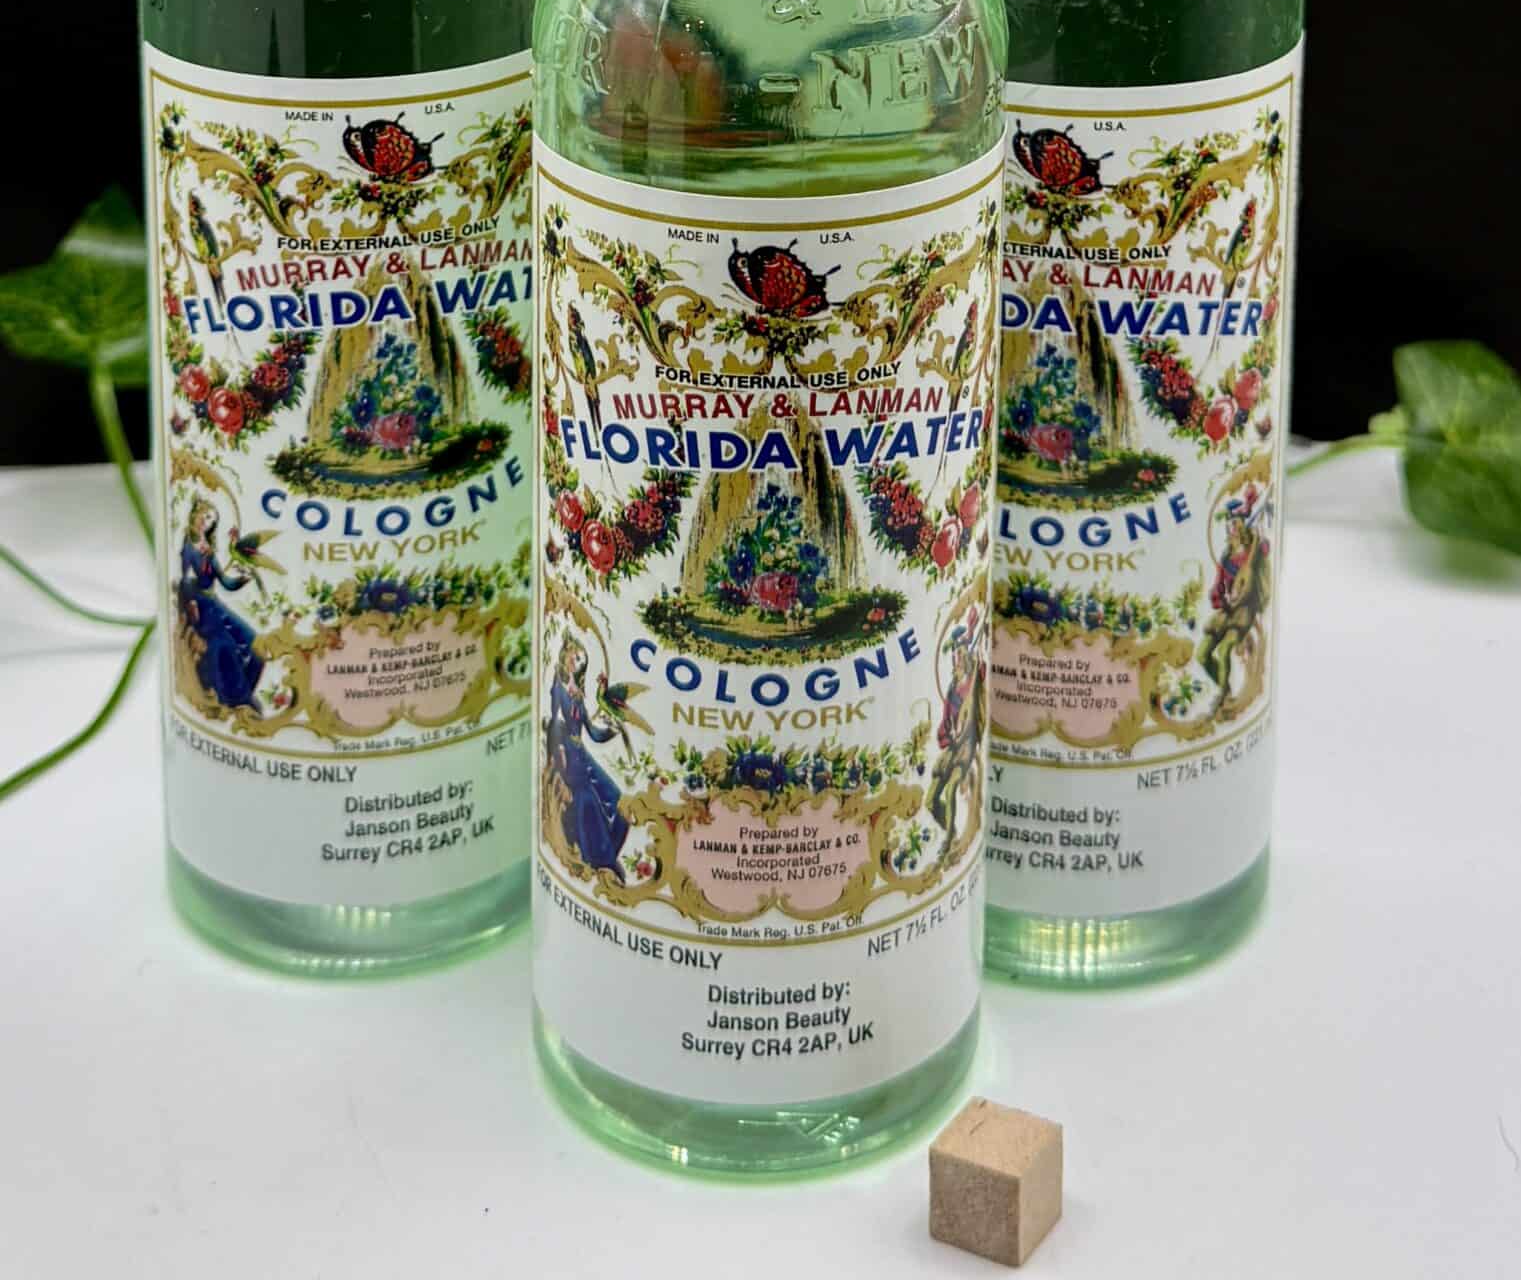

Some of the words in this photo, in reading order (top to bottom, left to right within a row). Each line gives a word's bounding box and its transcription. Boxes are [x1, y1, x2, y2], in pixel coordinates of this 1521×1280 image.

[284, 111, 318, 121] MADE
[321, 111, 334, 121] IN
[1093, 122, 1127, 131] U.S.A.
[278, 237, 313, 250] FOR
[319, 237, 412, 252] EXTERNAL
[420, 228, 453, 243] USE
[462, 216, 500, 236] ONLY
[667, 227, 701, 242] MADE
[703, 230, 720, 244] IN
[819, 230, 855, 245] U.S.A.
[1003, 241, 1076, 259] TERNAL
[1082, 247, 1119, 261] USE
[1128, 245, 1172, 260] ONLY
[236, 255, 370, 291] MURRAY
[386, 251, 410, 274] &
[1050, 263, 1073, 285] &
[1083, 265, 1216, 297] LANMAN
[183, 286, 412, 336] FLORIDA
[434, 265, 532, 315] WAT
[1098, 298, 1263, 336] WATER
[655, 366, 692, 383] FOR
[698, 373, 801, 390] EXTERNAL
[808, 371, 848, 389] USE
[857, 361, 901, 382] ONLY
[613, 392, 755, 420] MURRAY
[771, 393, 798, 418] &
[809, 386, 943, 416] LANMAN
[561, 417, 801, 472] FLORIDA
[826, 409, 982, 467] WATER
[260, 455, 524, 537] COLOGNE
[1000, 493, 1192, 548] LOGNE
[303, 541, 380, 562] NEW
[390, 526, 482, 559] YORK
[993, 543, 1033, 567] EW
[1042, 549, 1137, 572] YORK
[369, 646, 424, 659] Prepared
[427, 641, 441, 653] by
[1019, 654, 1072, 670] Prepared
[1076, 658, 1090, 671] by
[368, 666, 443, 687] Incorporated
[629, 627, 922, 707] COLOGNE
[1017, 681, 1092, 697] Incorporated
[671, 701, 763, 732] NEW
[767, 701, 868, 729] YORK
[485, 728, 513, 756] NET
[190, 732, 263, 773] EXTERNAL
[267, 759, 302, 780] USE
[307, 764, 357, 782] ONLY
[1137, 768, 1170, 790] NET
[344, 785, 443, 815] Distributed
[447, 780, 473, 803] by:
[990, 795, 1088, 823] Distributed
[1093, 807, 1121, 827] by:
[344, 815, 411, 838] Janson
[415, 801, 475, 831] Beauty
[739, 826, 799, 841] Prepared
[803, 825, 819, 838] by
[321, 843, 381, 864] Surrey
[386, 839, 423, 858] CR4
[427, 829, 467, 851] 2AP,
[472, 816, 495, 838] UK
[693, 839, 737, 854] LANMAN
[741, 844, 749, 855] &
[836, 837, 842, 849] &
[846, 833, 862, 845] CO.
[990, 820, 1053, 845] Janson
[1060, 830, 1120, 849] Beauty
[711, 867, 783, 883] Westwood,
[787, 869, 805, 880] NJ
[808, 862, 847, 879] 07675
[736, 854, 820, 869] Incorporated
[986, 847, 1023, 869] rrey
[1028, 851, 1065, 868] CR4
[1071, 854, 1111, 872] 2AP,
[1118, 850, 1143, 868] UK
[553, 886, 623, 946] EXTERNAL
[627, 932, 665, 960] USE
[669, 945, 723, 971] ONLY
[696, 922, 728, 937] Trade
[731, 925, 761, 938] Mark
[764, 927, 791, 940] Reg.
[794, 925, 818, 937] U.S.
[867, 927, 902, 957] NET
[707, 984, 817, 1007] Distributed
[821, 980, 852, 1004] by:
[706, 1011, 779, 1032] Janson
[784, 1006, 852, 1031] Beauty
[681, 1032, 744, 1061] Surrey
[751, 1034, 793, 1056] CR4
[798, 1032, 842, 1055] 2AP,
[848, 1022, 874, 1046] UK
